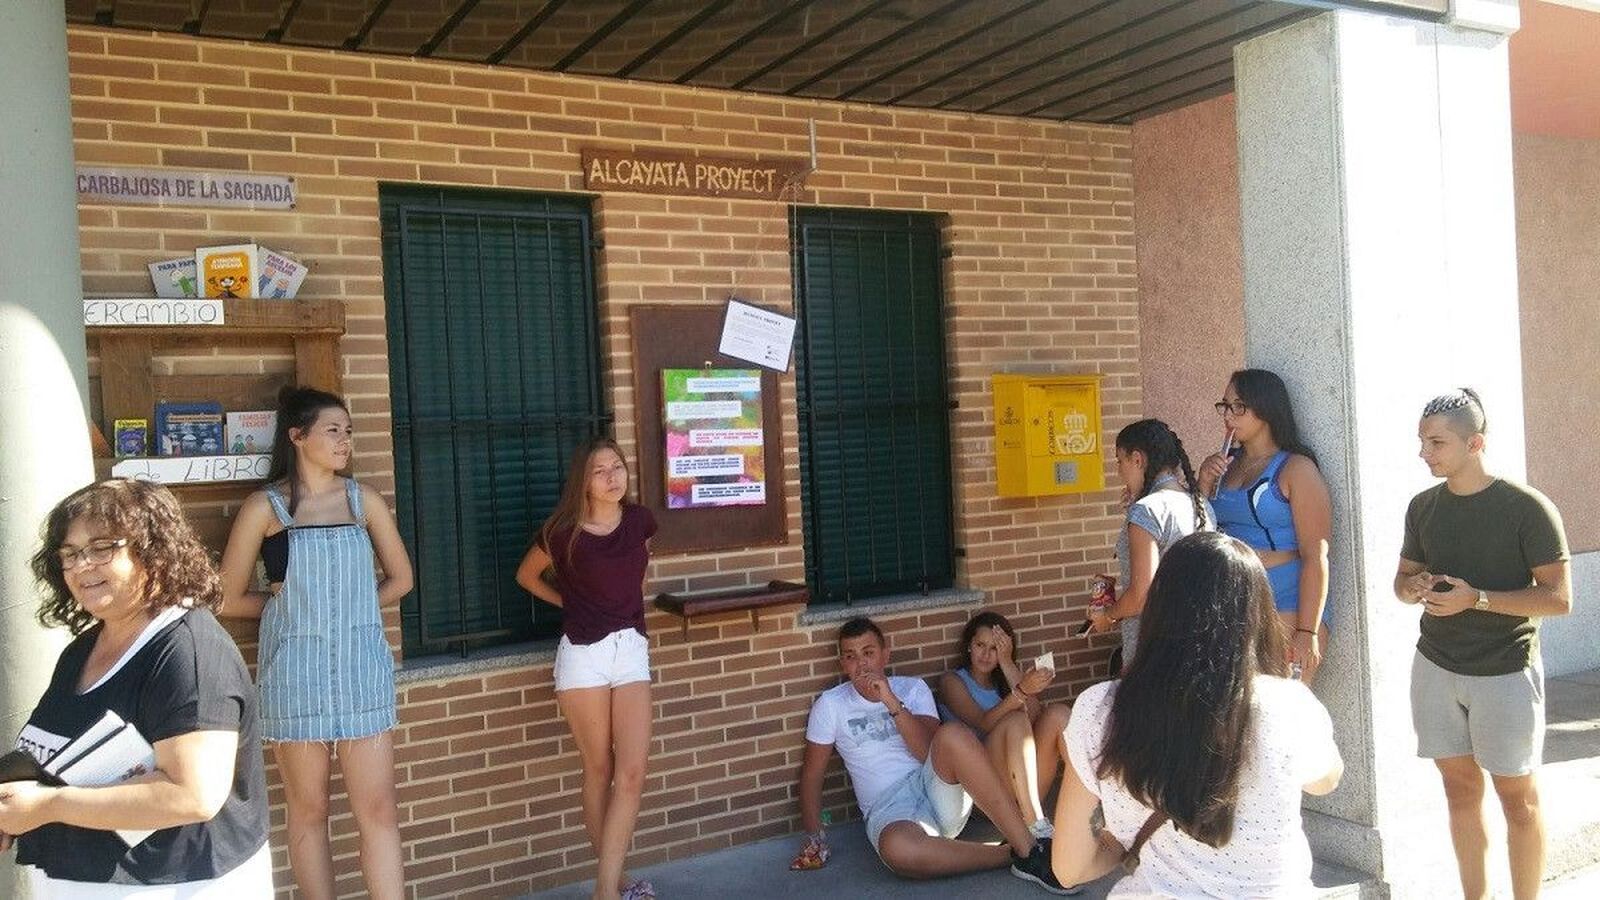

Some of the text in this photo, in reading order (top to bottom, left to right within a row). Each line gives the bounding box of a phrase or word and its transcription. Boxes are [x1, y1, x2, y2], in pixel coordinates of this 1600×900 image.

[77, 174, 293, 202] CARBAJOSA DE LA SAGRADA
[590, 158, 776, 193] ALCAYATA PROYECT
